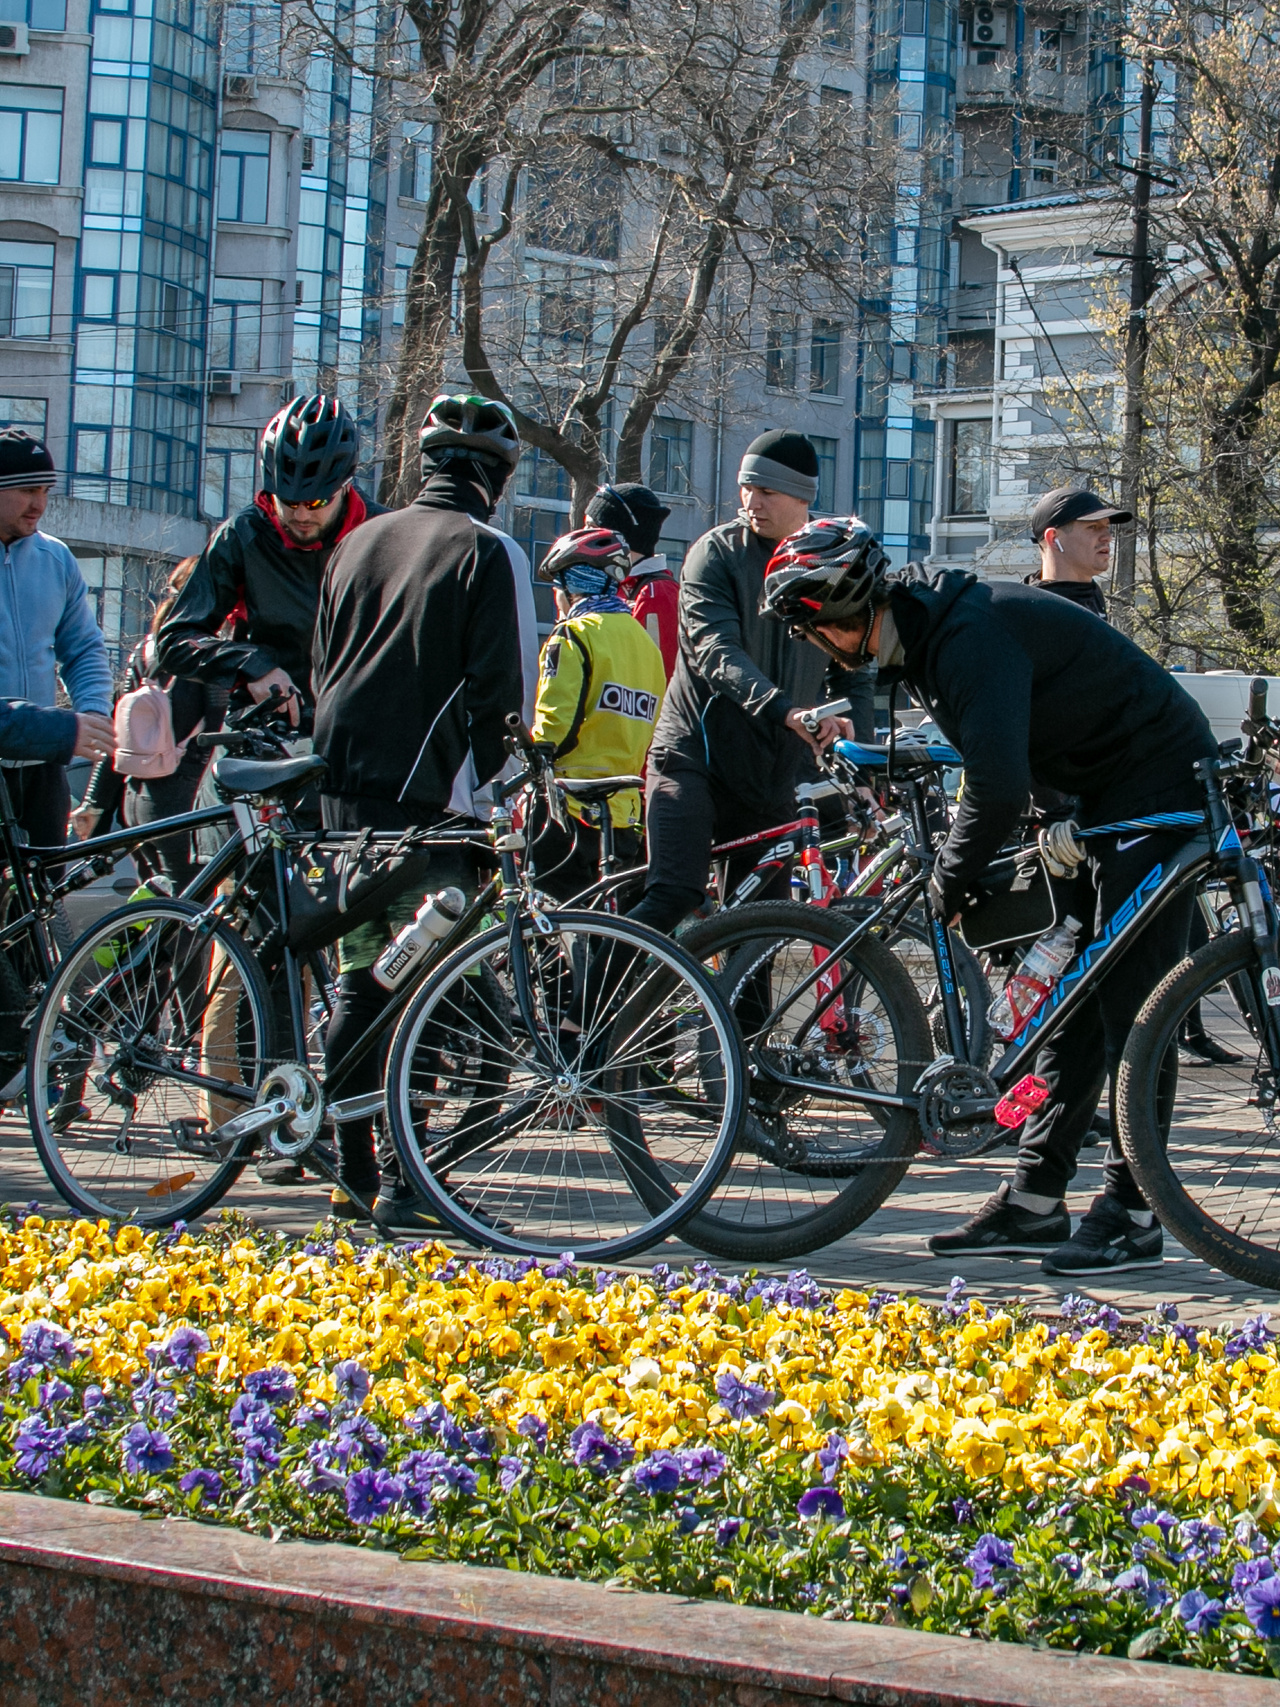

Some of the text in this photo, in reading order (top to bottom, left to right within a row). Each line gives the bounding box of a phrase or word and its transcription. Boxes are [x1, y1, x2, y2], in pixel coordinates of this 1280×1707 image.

[757, 840, 795, 865] 29
[386, 953, 409, 978] DUUTI
[1014, 863, 1163, 1047] WINNER
[940, 961, 954, 995] 27.5
[1201, 1225, 1259, 1260] KENDA
